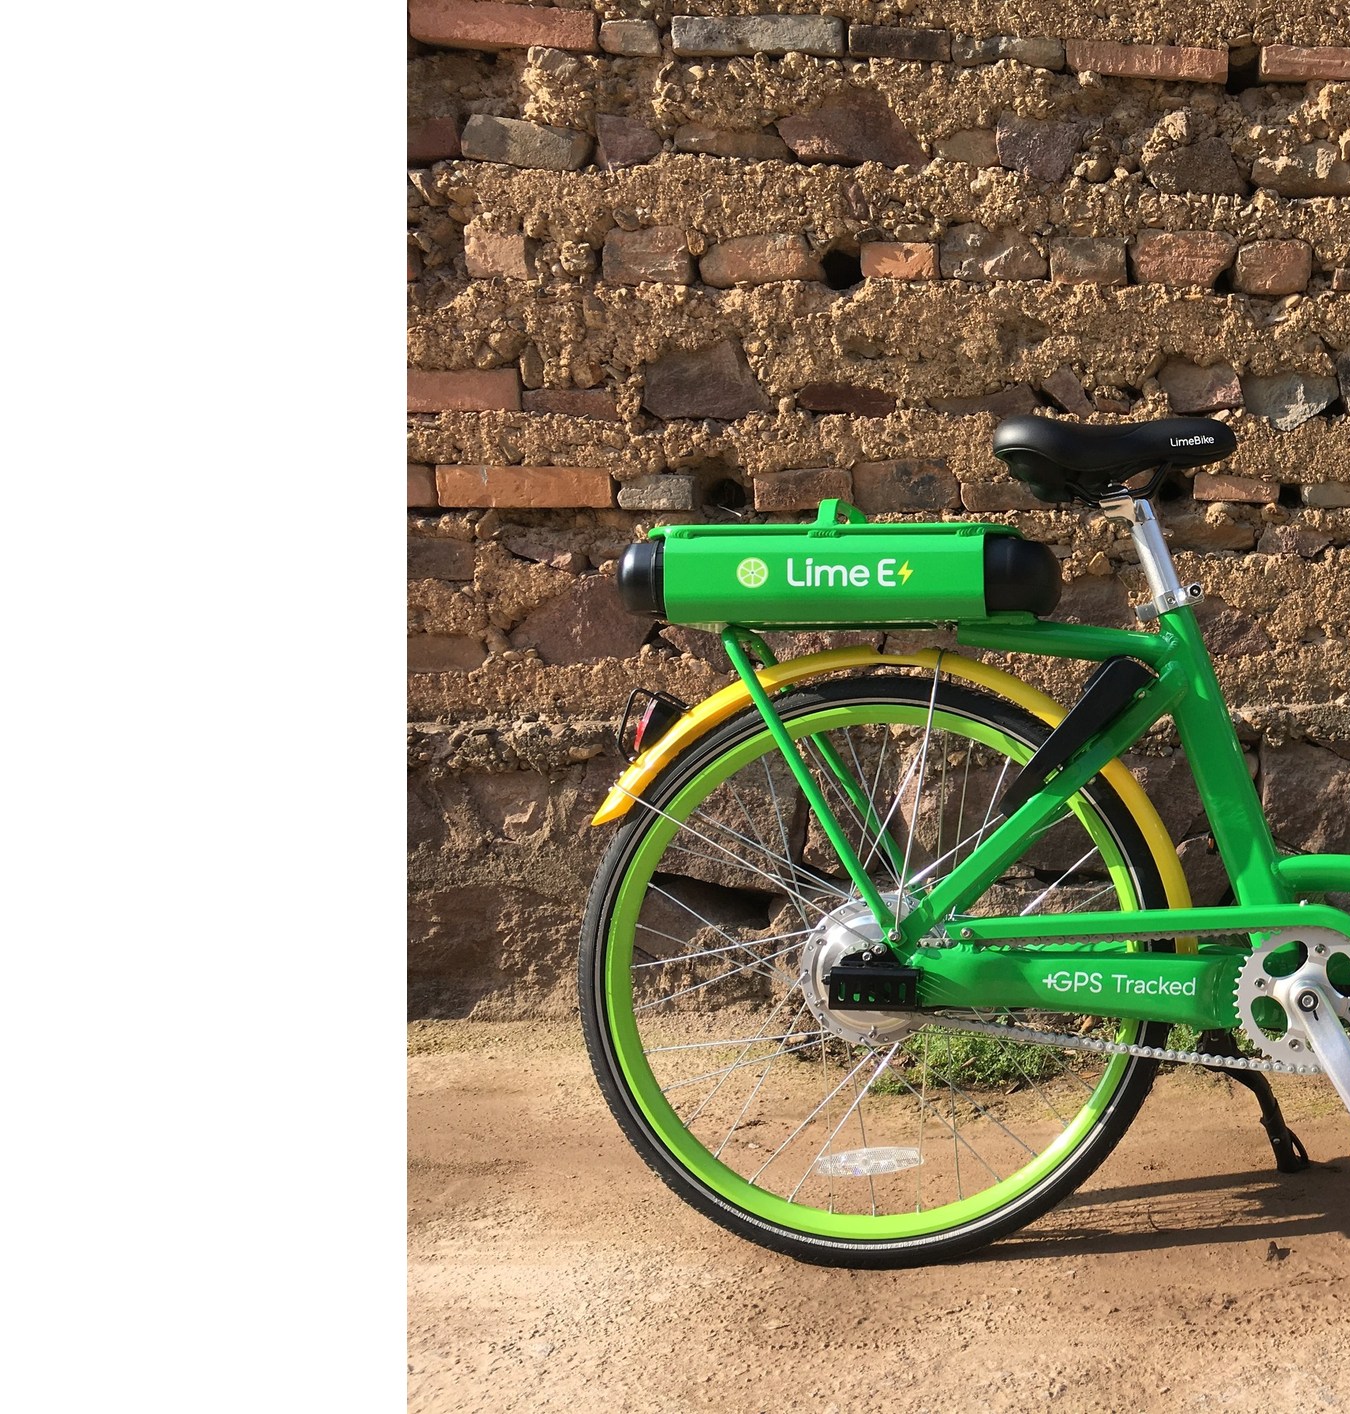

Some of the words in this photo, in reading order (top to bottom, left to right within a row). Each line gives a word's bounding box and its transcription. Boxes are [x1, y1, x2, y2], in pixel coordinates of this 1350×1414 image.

[1169, 435, 1215, 448] LimeBike
[786, 557, 871, 588] Lime
[876, 557, 898, 588] E
[1111, 974, 1197, 996] Tracked
